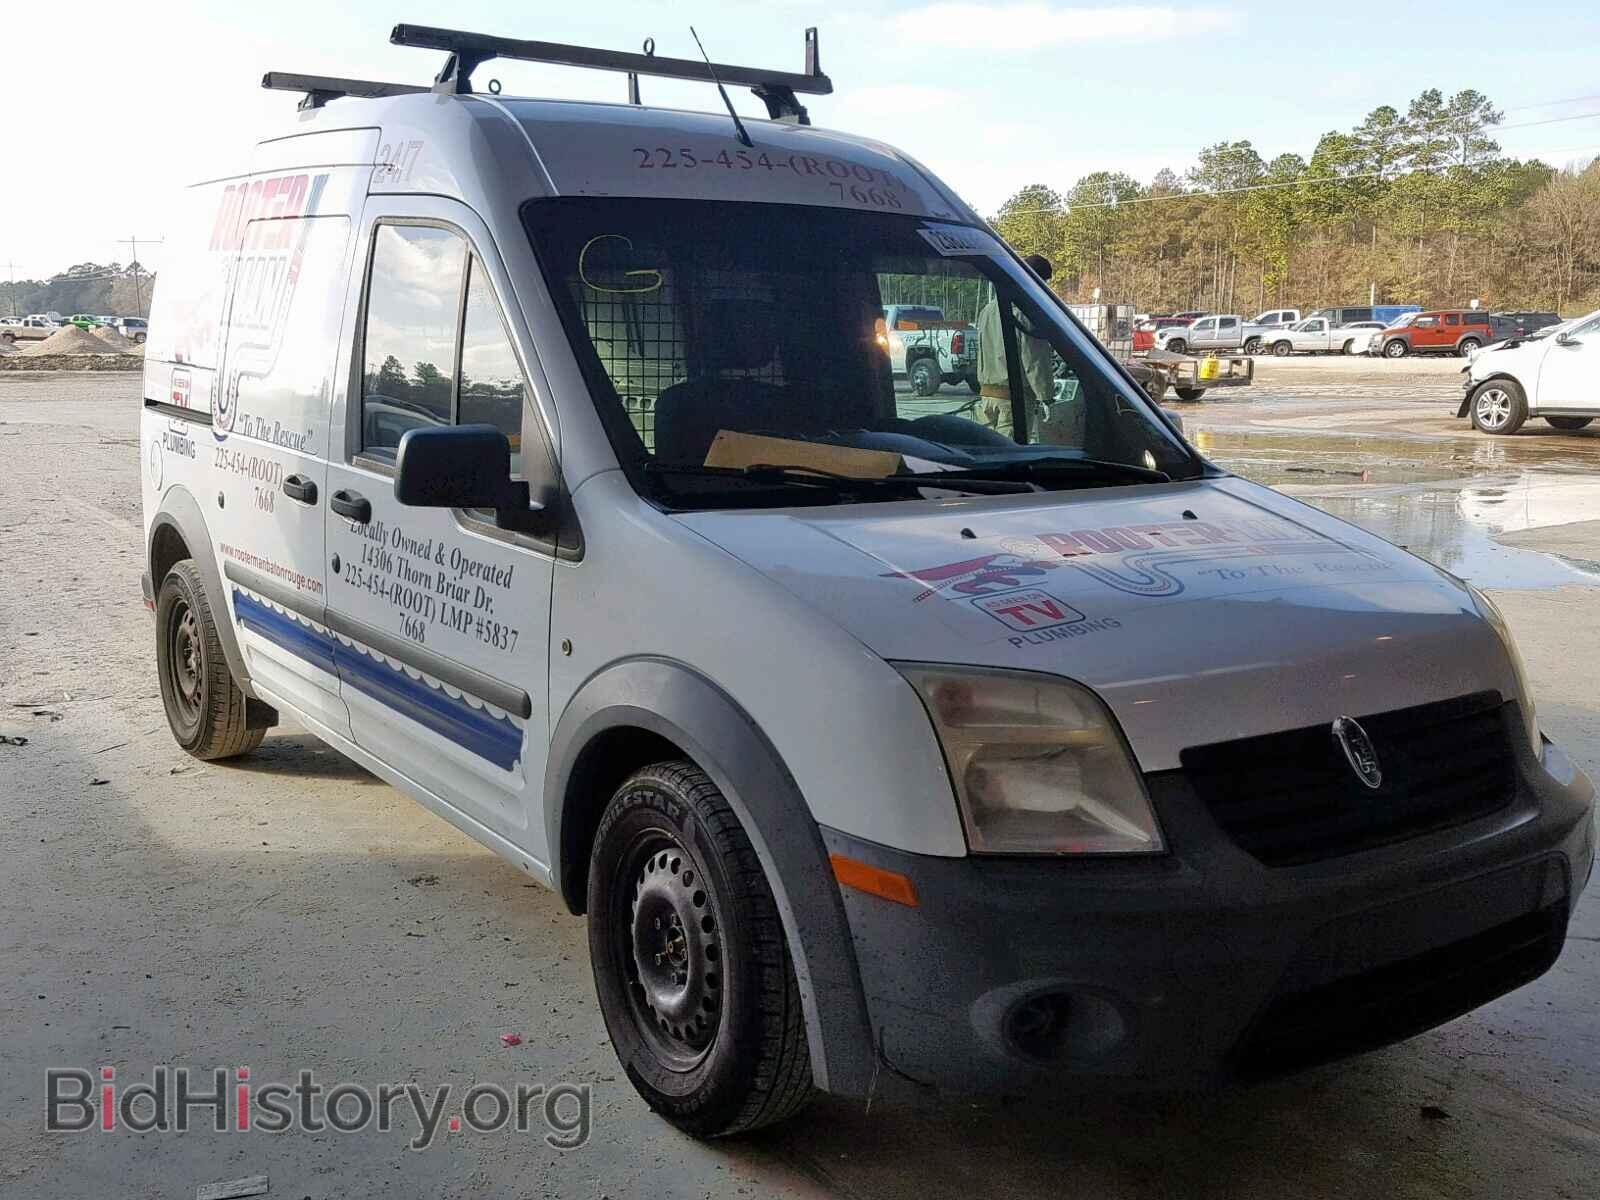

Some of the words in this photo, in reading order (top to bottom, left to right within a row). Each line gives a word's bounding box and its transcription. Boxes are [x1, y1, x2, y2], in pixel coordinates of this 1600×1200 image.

[633, 148, 906, 193] 225-454-(ROOT)
[829, 181, 902, 209] 7668
[256, 416, 271, 441] The
[163, 431, 196, 459] PLUMBING
[214, 447, 284, 490] 225-454-(ROOT)
[255, 486, 275, 513] 7668
[351, 521, 388, 546] Locally
[391, 527, 432, 561] Owned
[435, 542, 446, 566] &
[450, 547, 514, 590] Operated
[361, 544, 393, 575] 14306
[397, 556, 432, 590] Thorn
[436, 571, 470, 603] Briar
[473, 586, 494, 615] Dr.
[344, 563, 436, 624] 225-454-(ROOT)
[440, 602, 473, 634] LMP
[476, 616, 520, 653] #5837
[994, 599, 1066, 626] TV
[399, 612, 426, 643] 7668
[1008, 616, 1121, 649] PLUMBING
